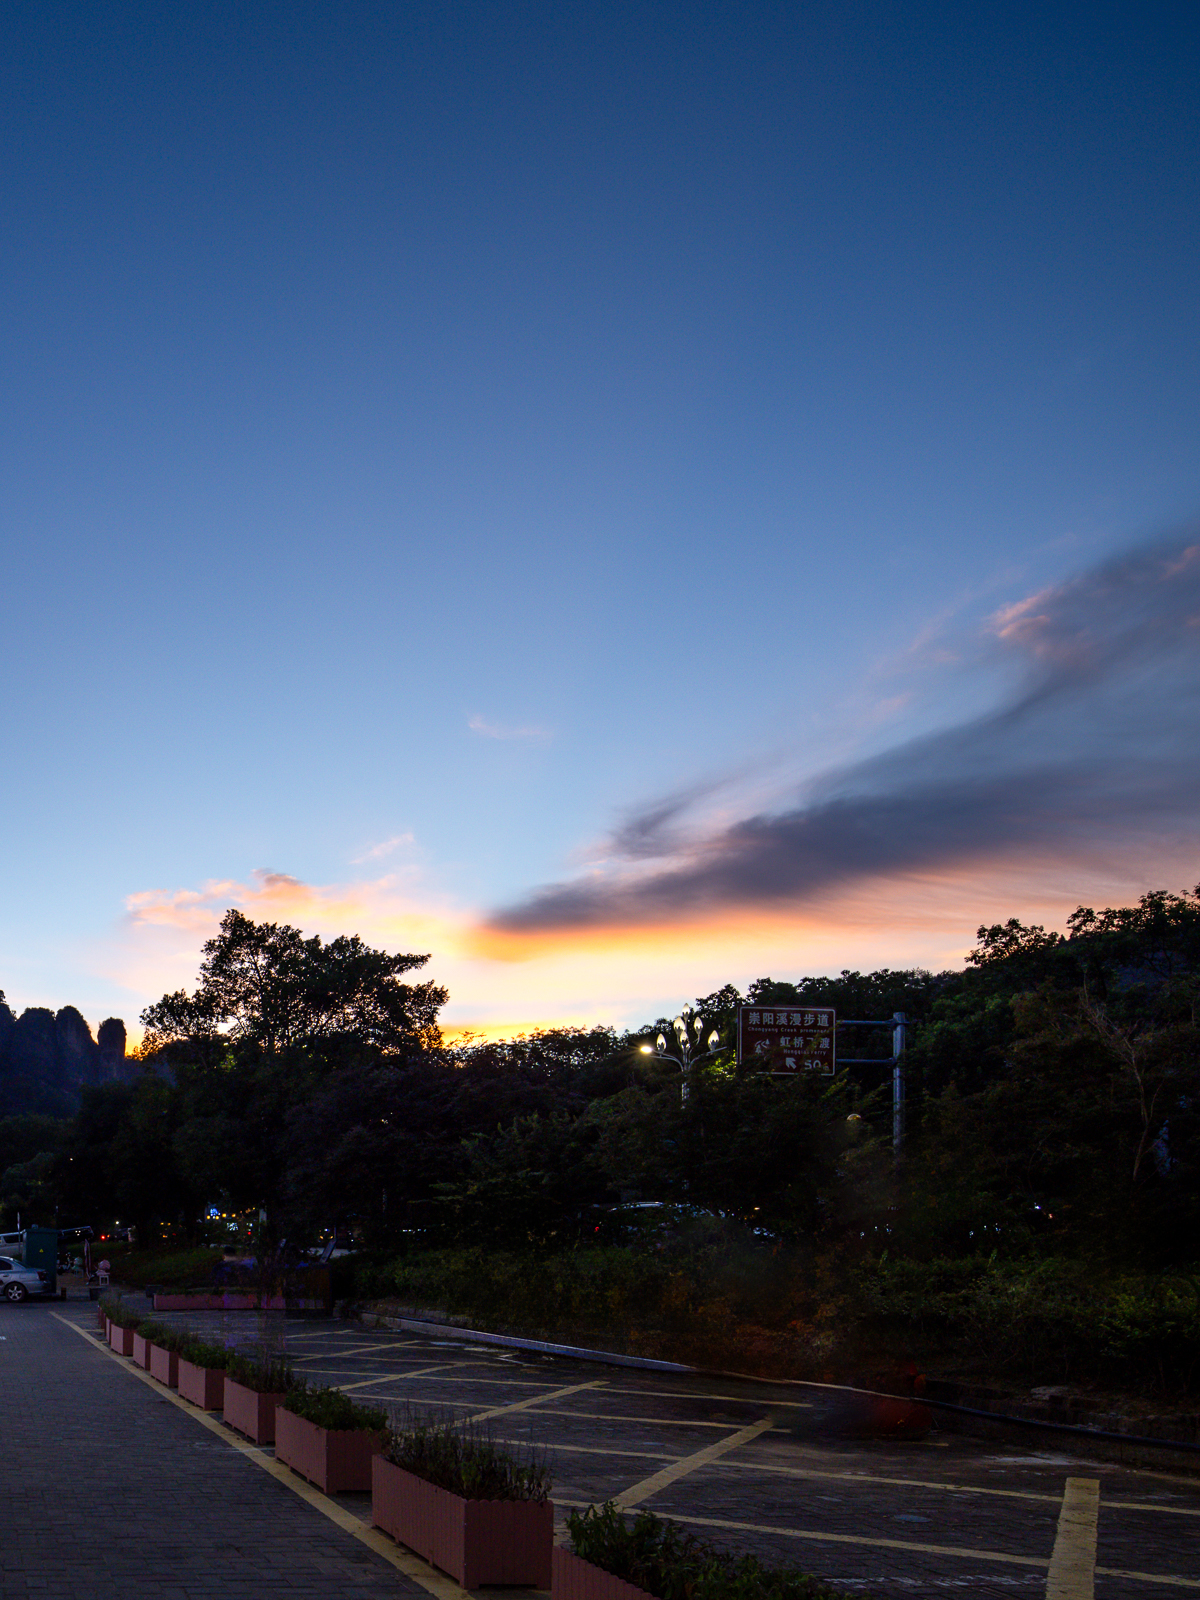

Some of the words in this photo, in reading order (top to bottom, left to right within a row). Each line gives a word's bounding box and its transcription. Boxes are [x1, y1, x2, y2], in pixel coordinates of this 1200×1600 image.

[748, 1012, 829, 1027] 崇阳溪漫步道
